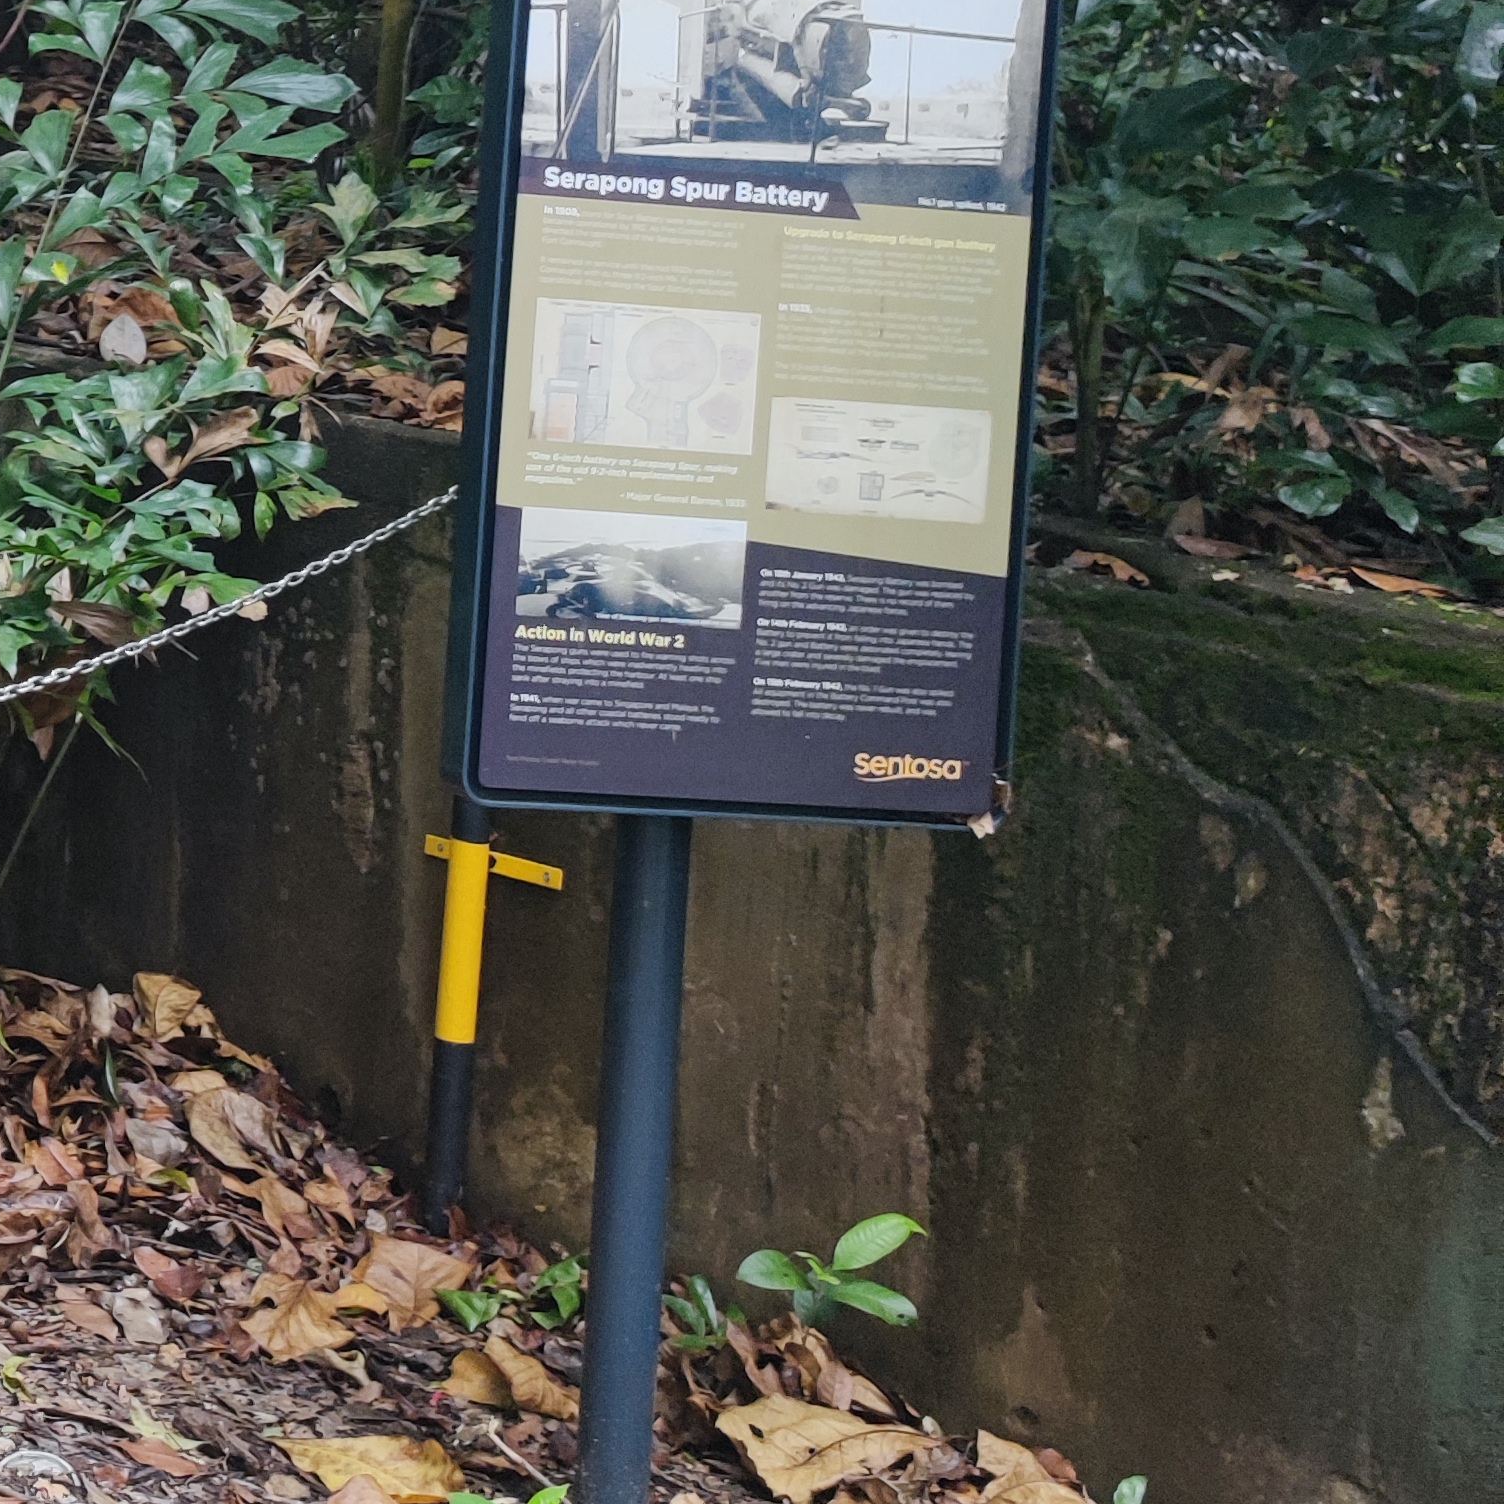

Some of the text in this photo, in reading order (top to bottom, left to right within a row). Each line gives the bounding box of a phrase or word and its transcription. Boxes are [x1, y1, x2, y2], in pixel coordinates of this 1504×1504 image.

[543, 166, 829, 212] Serapong Spur Battery
[514, 624, 685, 648] Action in World War 2
